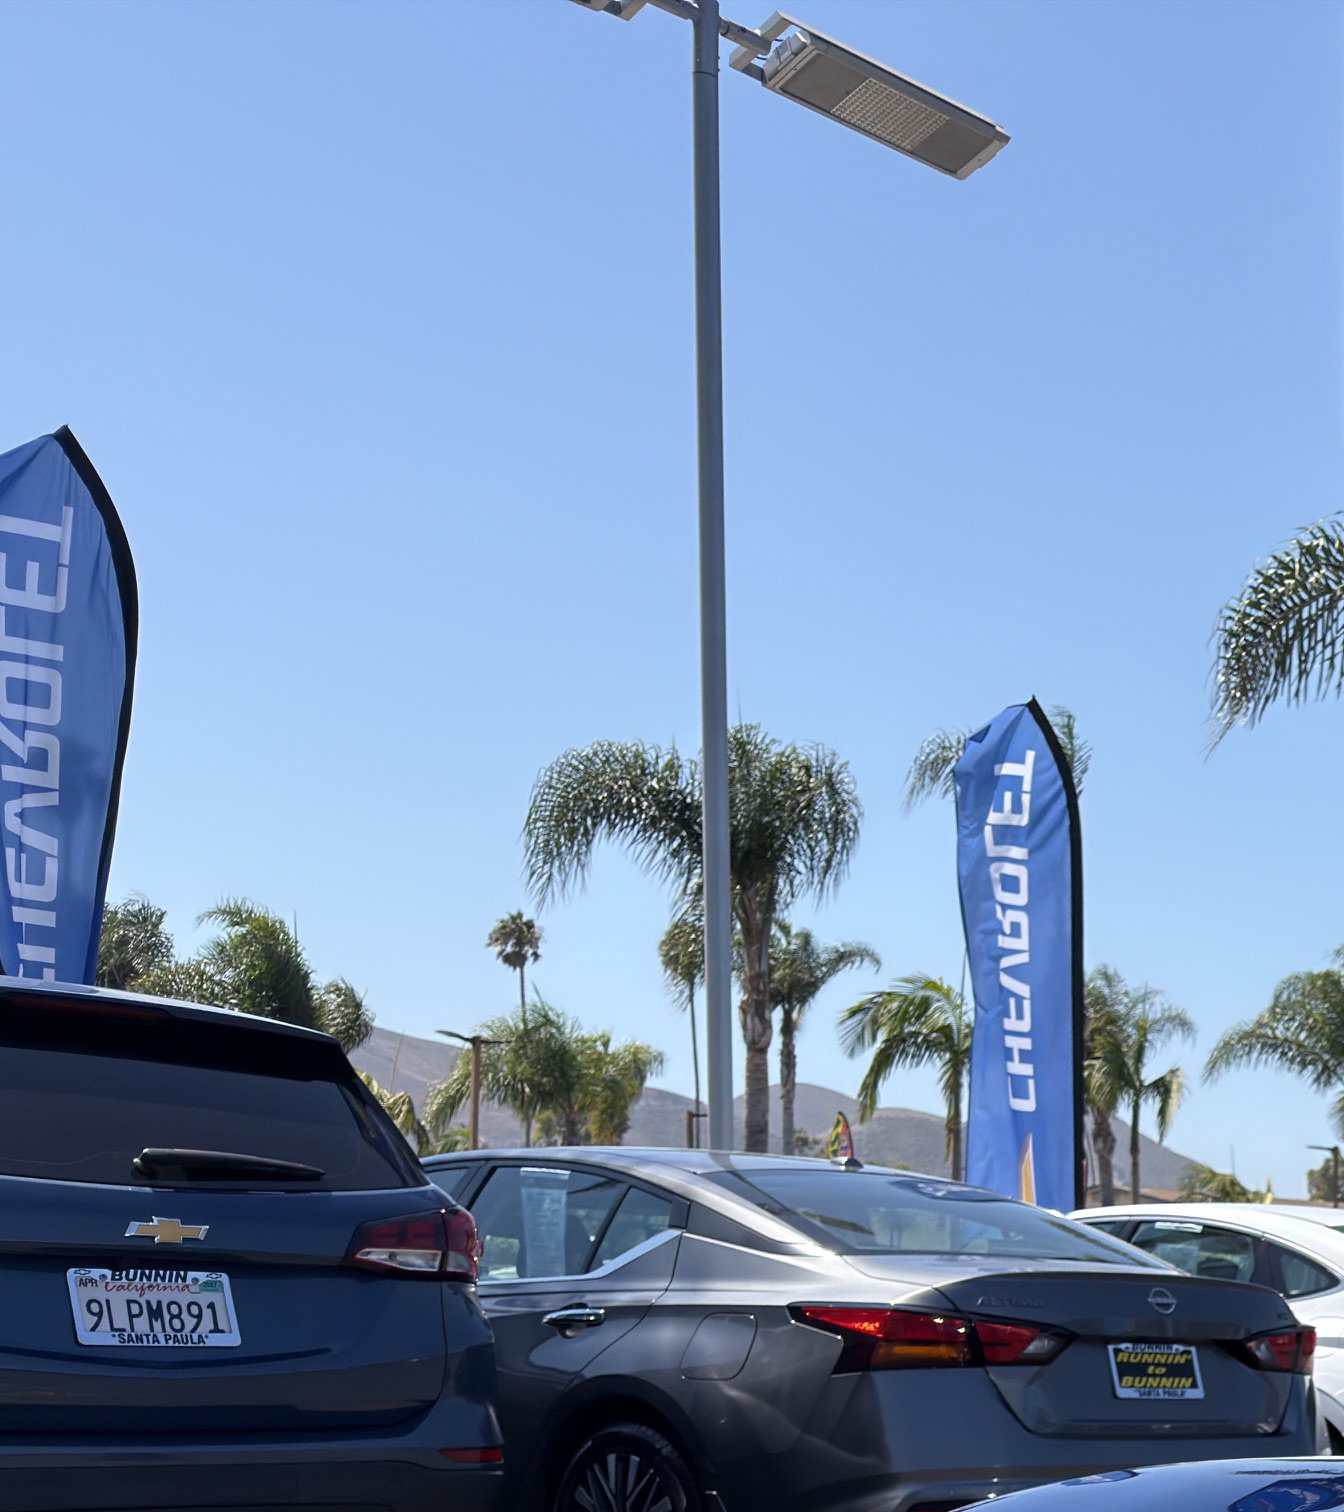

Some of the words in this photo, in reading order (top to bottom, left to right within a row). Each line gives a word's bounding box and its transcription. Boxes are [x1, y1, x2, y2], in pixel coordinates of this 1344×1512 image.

[110, 1269, 188, 1283] BUNNIN
[78, 1278, 98, 1288] APR
[104, 1282, 200, 1297] California
[86, 1299, 226, 1333] 9LPM891
[1147, 1365, 1167, 1375] to
[1121, 1376, 1193, 1388] BUNNIN
